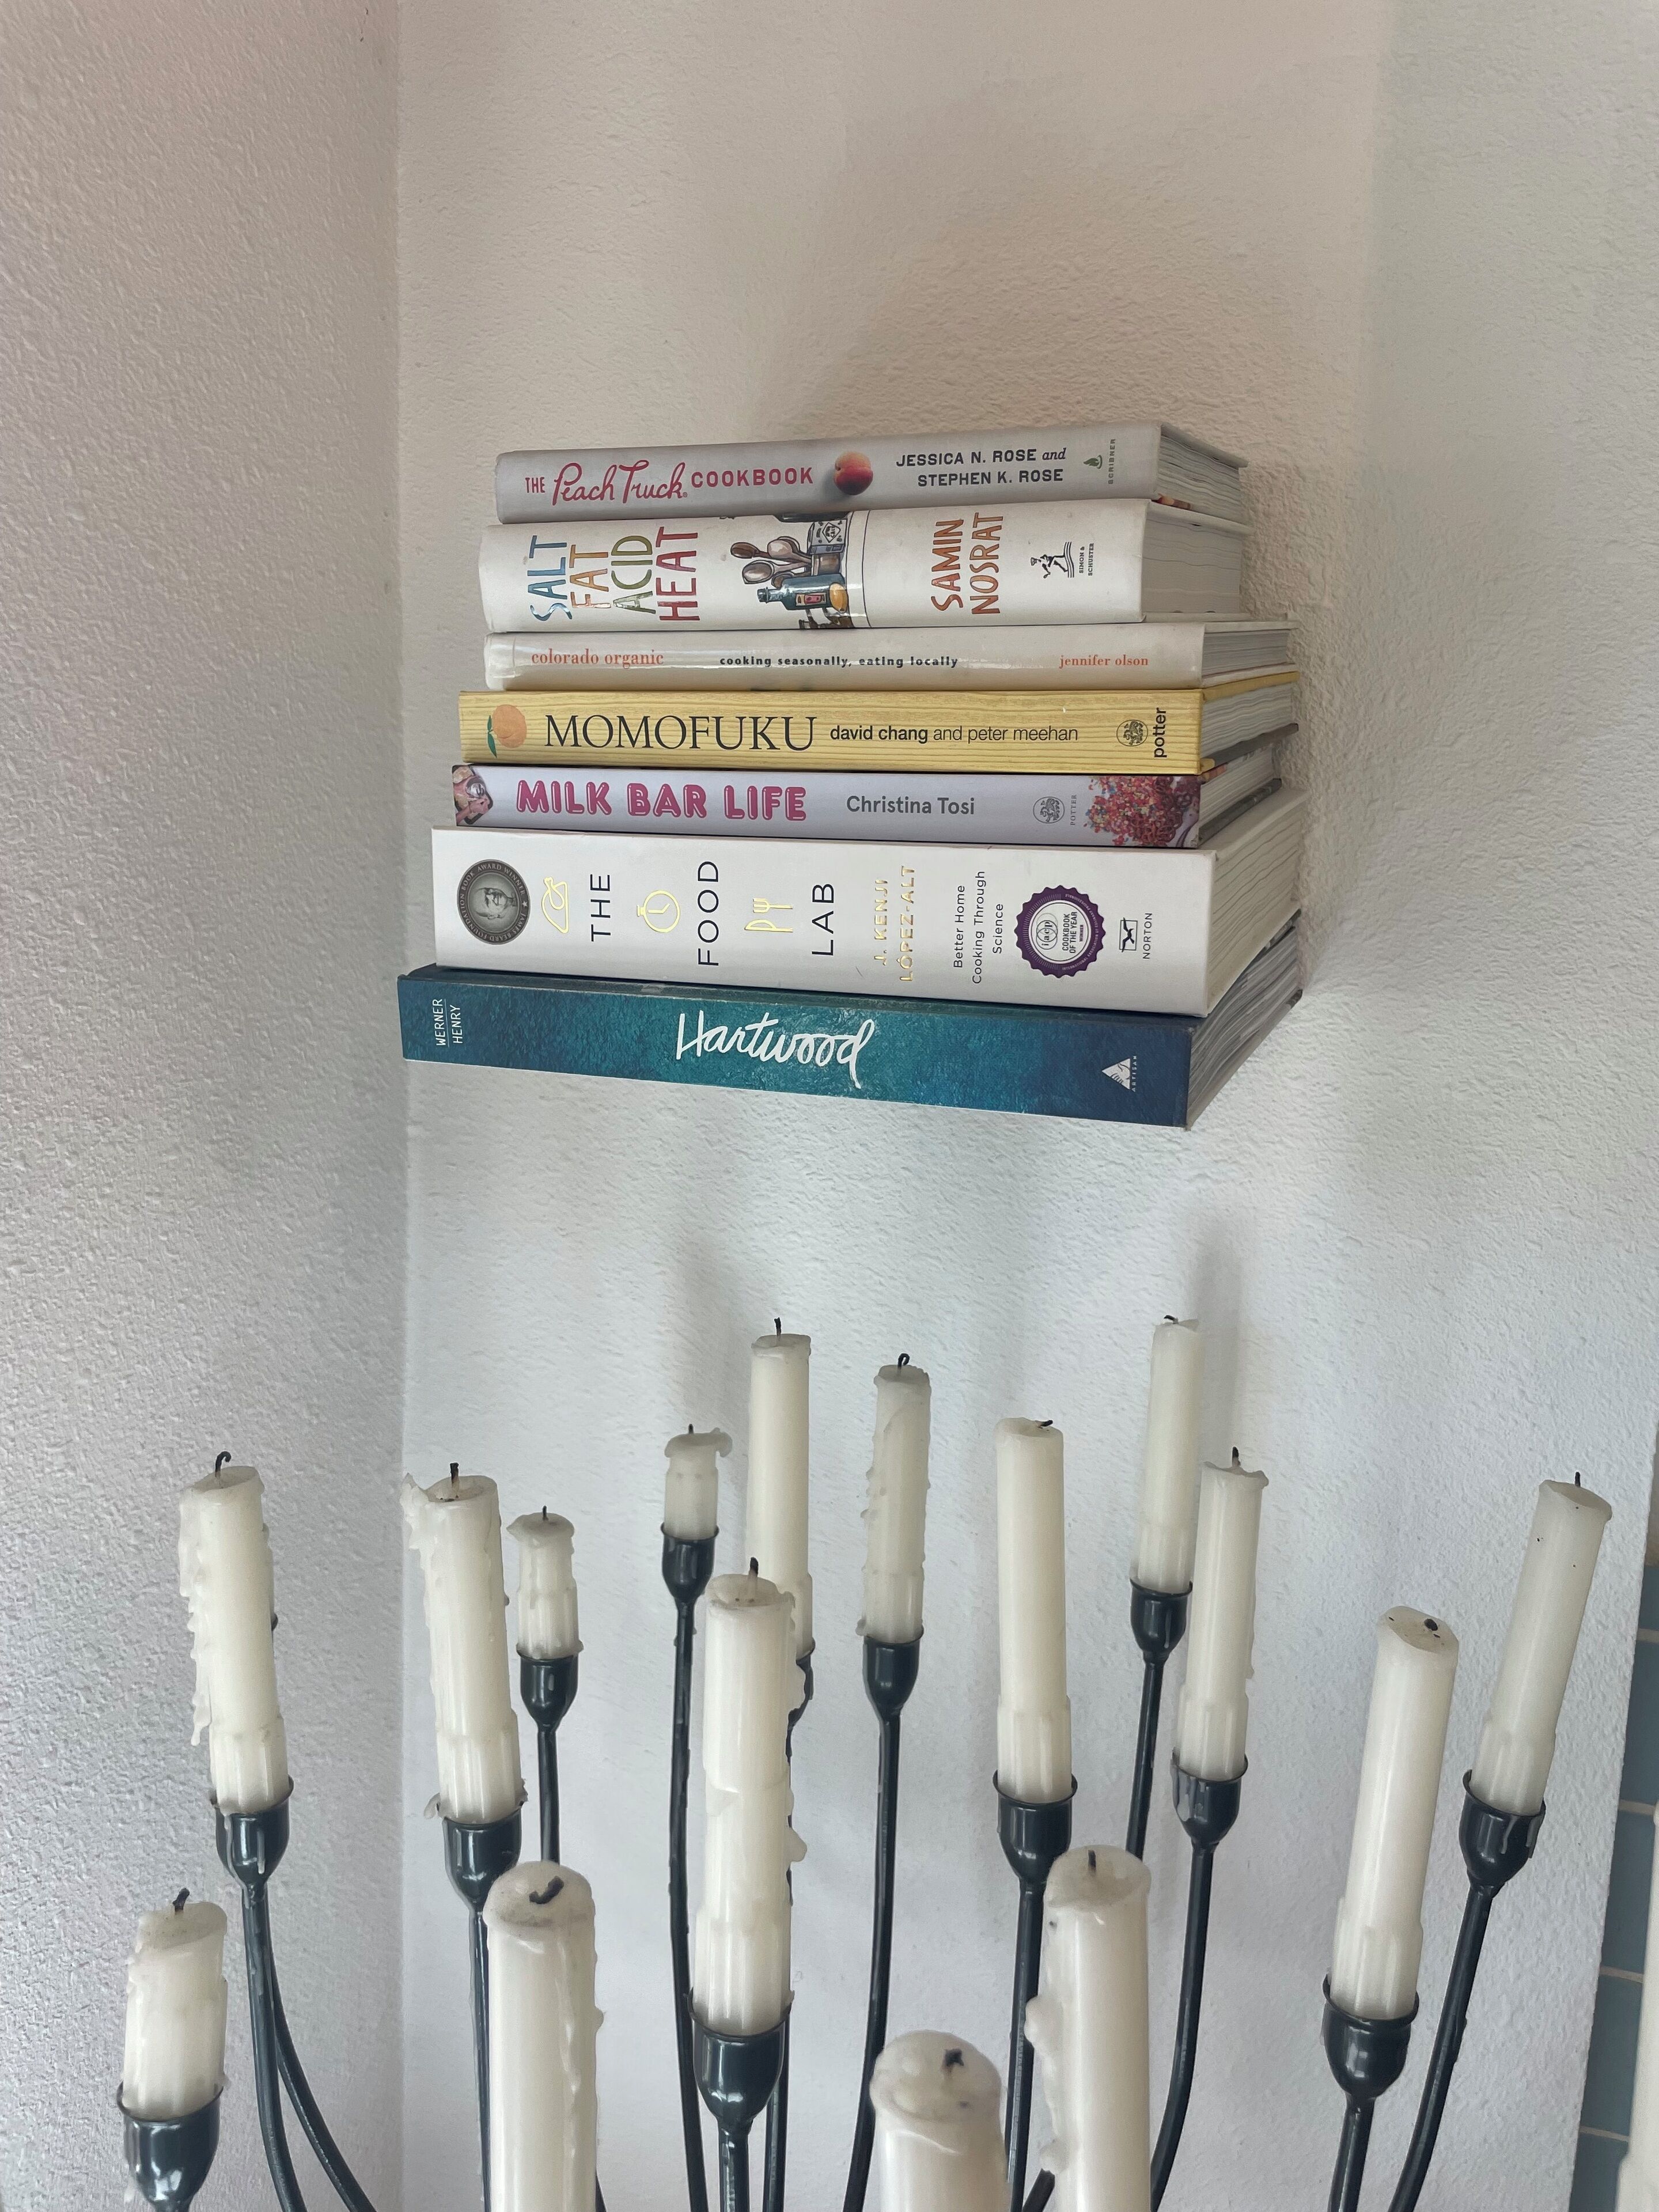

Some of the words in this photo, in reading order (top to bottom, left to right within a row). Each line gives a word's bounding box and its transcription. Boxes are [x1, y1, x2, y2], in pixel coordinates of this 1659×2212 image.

[896, 452, 964, 467] JESSICA
[971, 450, 987, 464] N.
[992, 449, 1036, 463] ROSE
[1042, 447, 1066, 461] and
[918, 472, 991, 487] STEPHEN
[997, 470, 1012, 484] K.
[1018, 468, 1063, 483] ROSE
[1108, 438, 1116, 484] SCRIBNER
[525, 476, 545, 494] THE
[552, 462, 618, 506] Peach
[691, 467, 813, 488] COOKBOOK
[528, 535, 573, 622] SALT
[569, 544, 611, 609] FAT
[611, 535, 656, 615] ACID
[656, 526, 700, 622] HEAT
[931, 518, 964, 612] SAMIN
[969, 512, 1003, 615] NOSRAT
[532, 648, 599, 665] colorado
[605, 649, 664, 669] organic
[720, 656, 771, 668] cooking
[777, 656, 852, 668] seasonally,
[858, 656, 903, 668] eating
[910, 656, 958, 668] locally
[1059, 654, 1111, 669] jennifer
[1115, 654, 1149, 666] olson
[545, 714, 817, 751] MOMOFUKU
[830, 725, 873, 741] david
[878, 725, 928, 744] chang
[933, 726, 962, 741] and
[967, 727, 1008, 744] peter
[1013, 726, 1078, 741] meehan
[1153, 707, 1167, 757] potter
[516, 779, 612, 816] MILK
[627, 783, 707, 819] BAR
[724, 785, 806, 821] LIFE
[847, 795, 932, 814] Christina
[937, 797, 975, 815] Tosi
[477, 863, 502, 873] AWARD
[590, 874, 611, 941] THE
[698, 861, 719, 966] FOOD
[812, 883, 834, 956] LAB
[874, 879, 888, 940] KENJI
[955, 885, 965, 923] Home
[974, 871, 986, 926] Through
[953, 928, 964, 968] Better
[993, 903, 1003, 954] Science
[1062, 914, 1070, 951] COOKBOOK
[1069, 944, 1076, 953] OF
[1142, 912, 1152, 960] NORTON
[874, 950, 887, 965] J.
[972, 931, 984, 984] Cooking
[435, 998, 445, 1046] WERNER
[451, 1005, 463, 1044] HENRY
[676, 1009, 874, 1089] Hartwood
